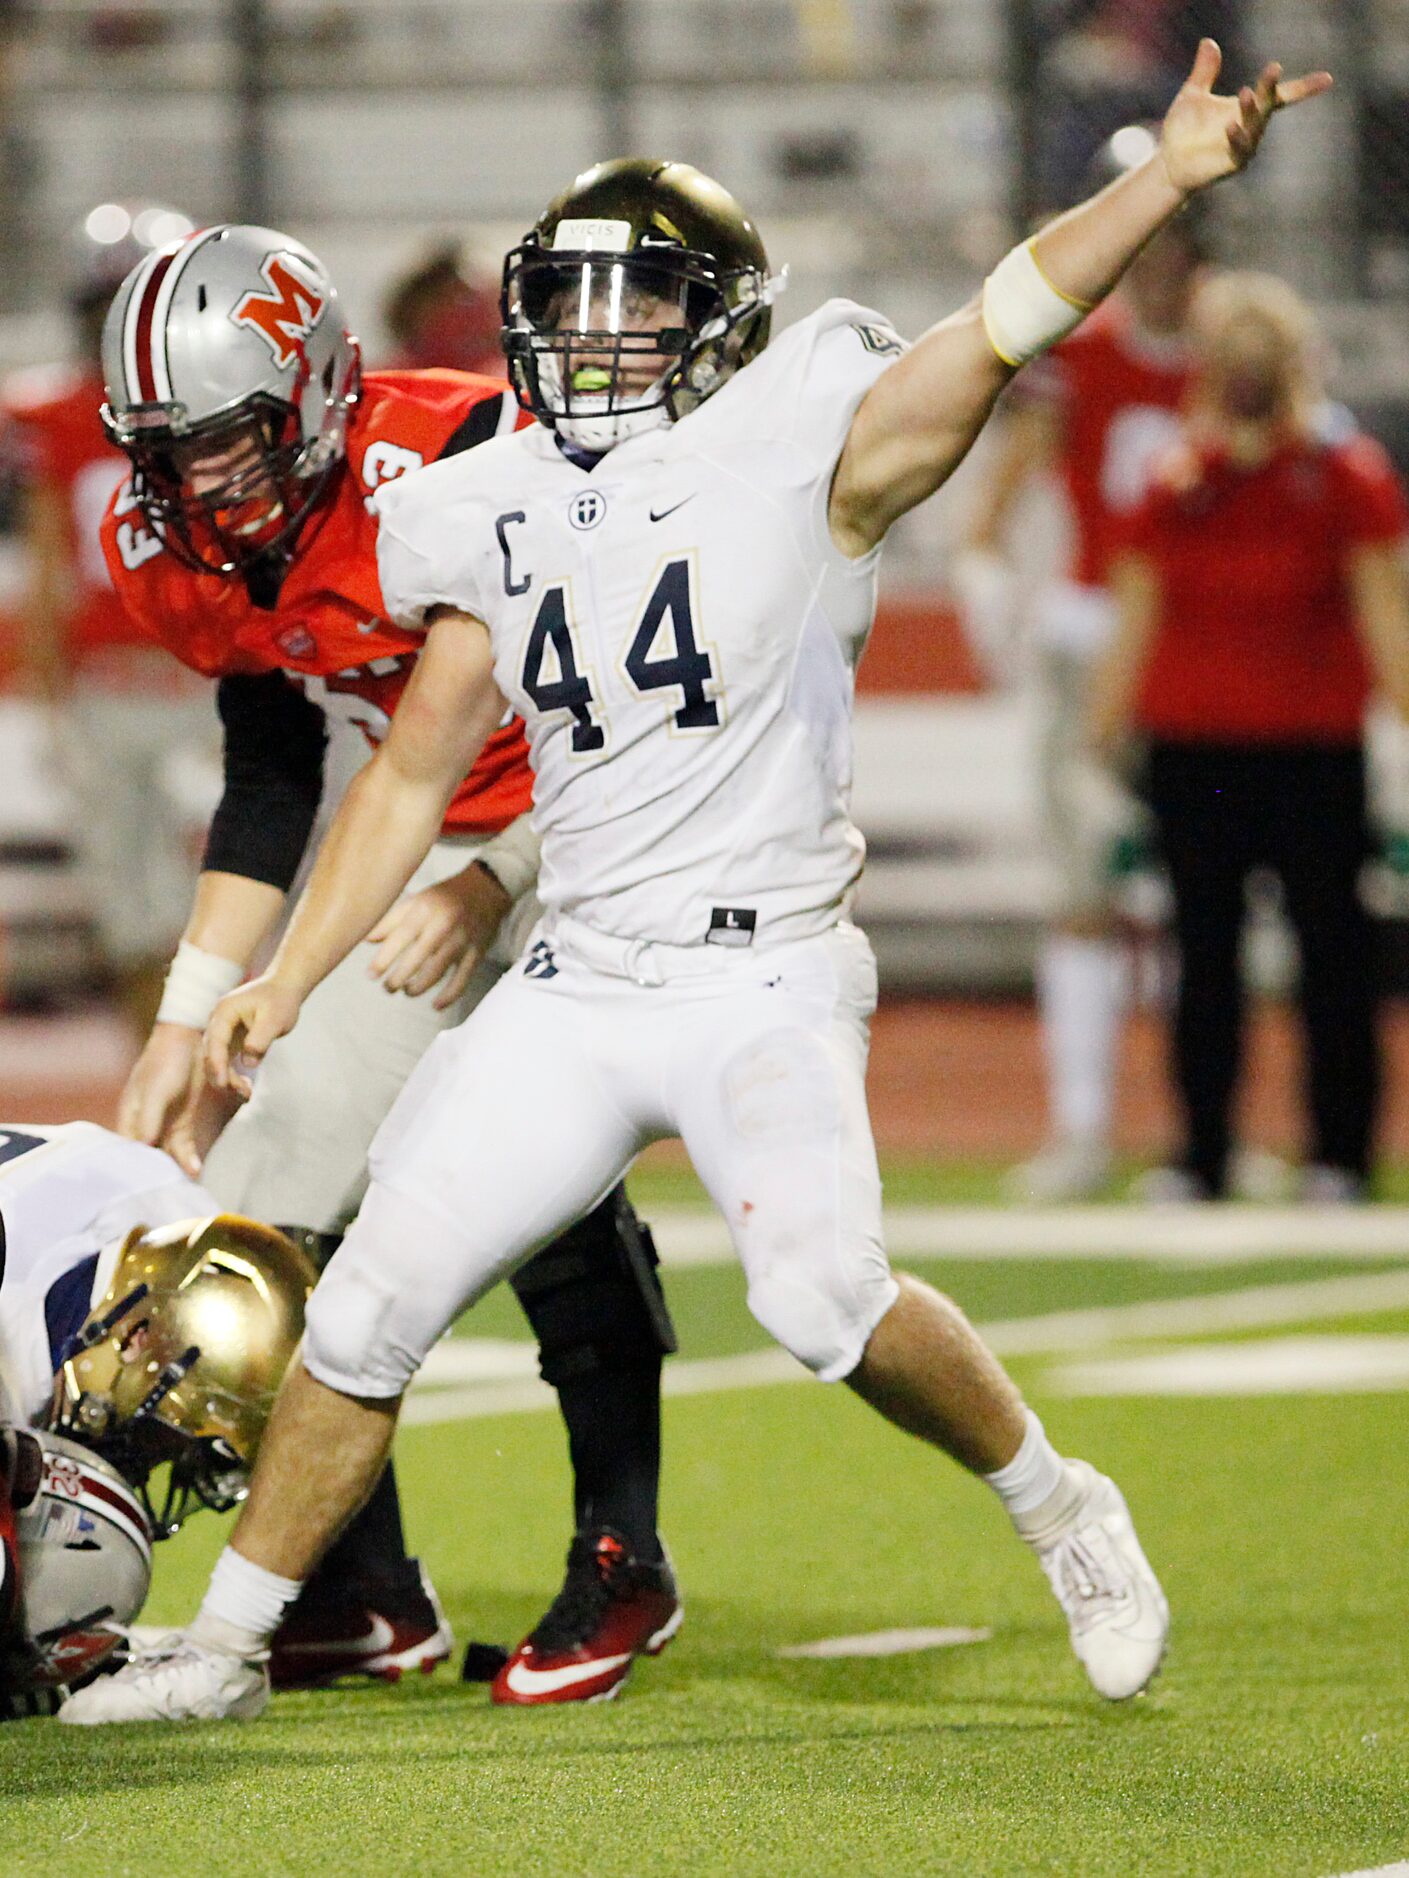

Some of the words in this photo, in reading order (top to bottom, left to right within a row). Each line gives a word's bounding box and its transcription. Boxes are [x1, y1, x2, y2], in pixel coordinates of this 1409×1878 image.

[568, 223, 615, 236] VICIS
[495, 511, 532, 597] C
[519, 552, 723, 756] 44
[726, 910, 740, 929] L
